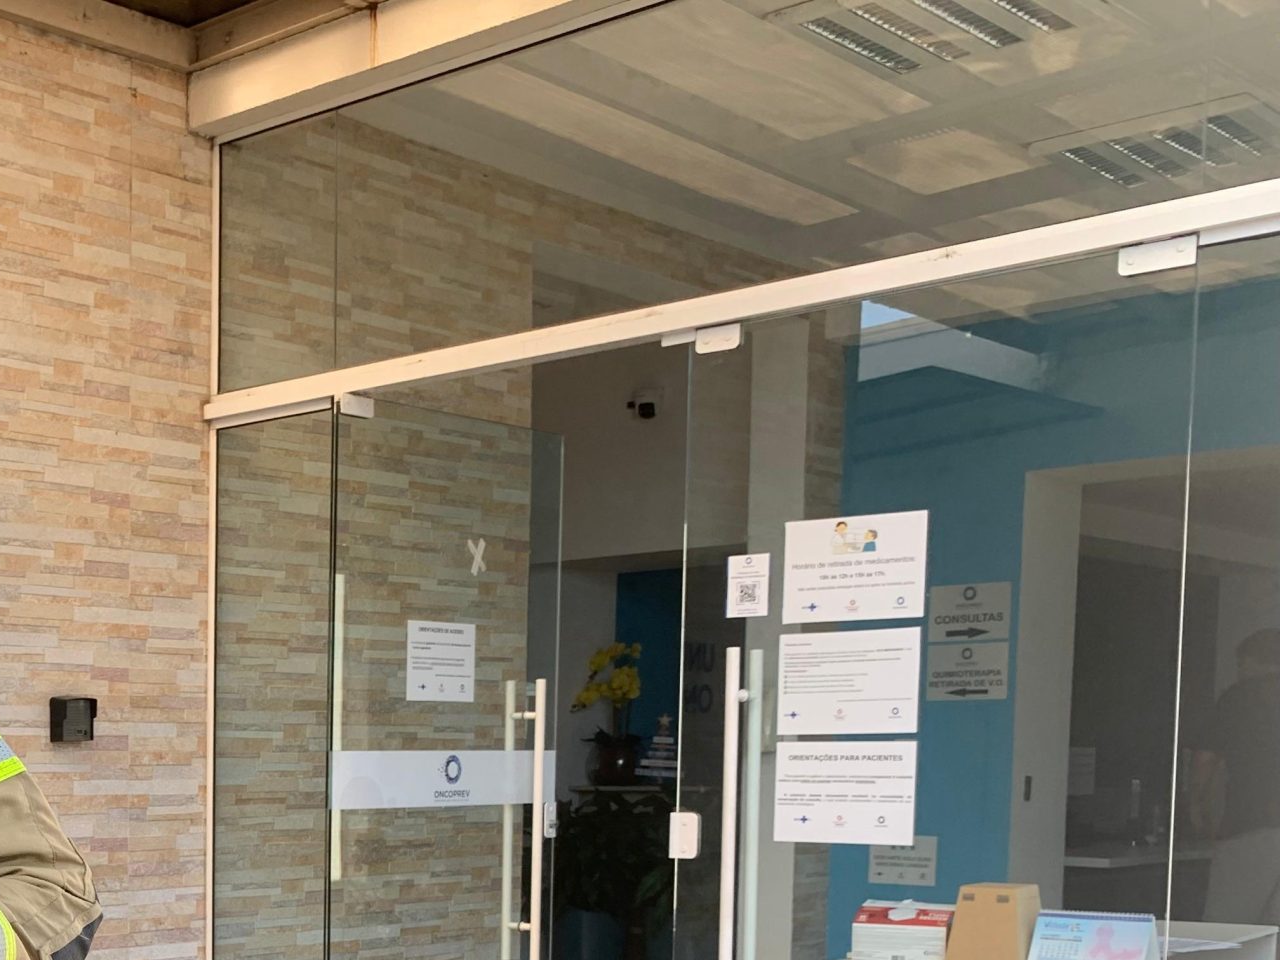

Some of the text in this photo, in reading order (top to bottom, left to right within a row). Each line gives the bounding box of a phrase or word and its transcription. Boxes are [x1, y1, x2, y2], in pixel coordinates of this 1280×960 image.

[934, 611, 1004, 625] CONSULTAS
[788, 753, 839, 762] ORIENTAÇÕES
[861, 754, 903, 762] PACIENTES
